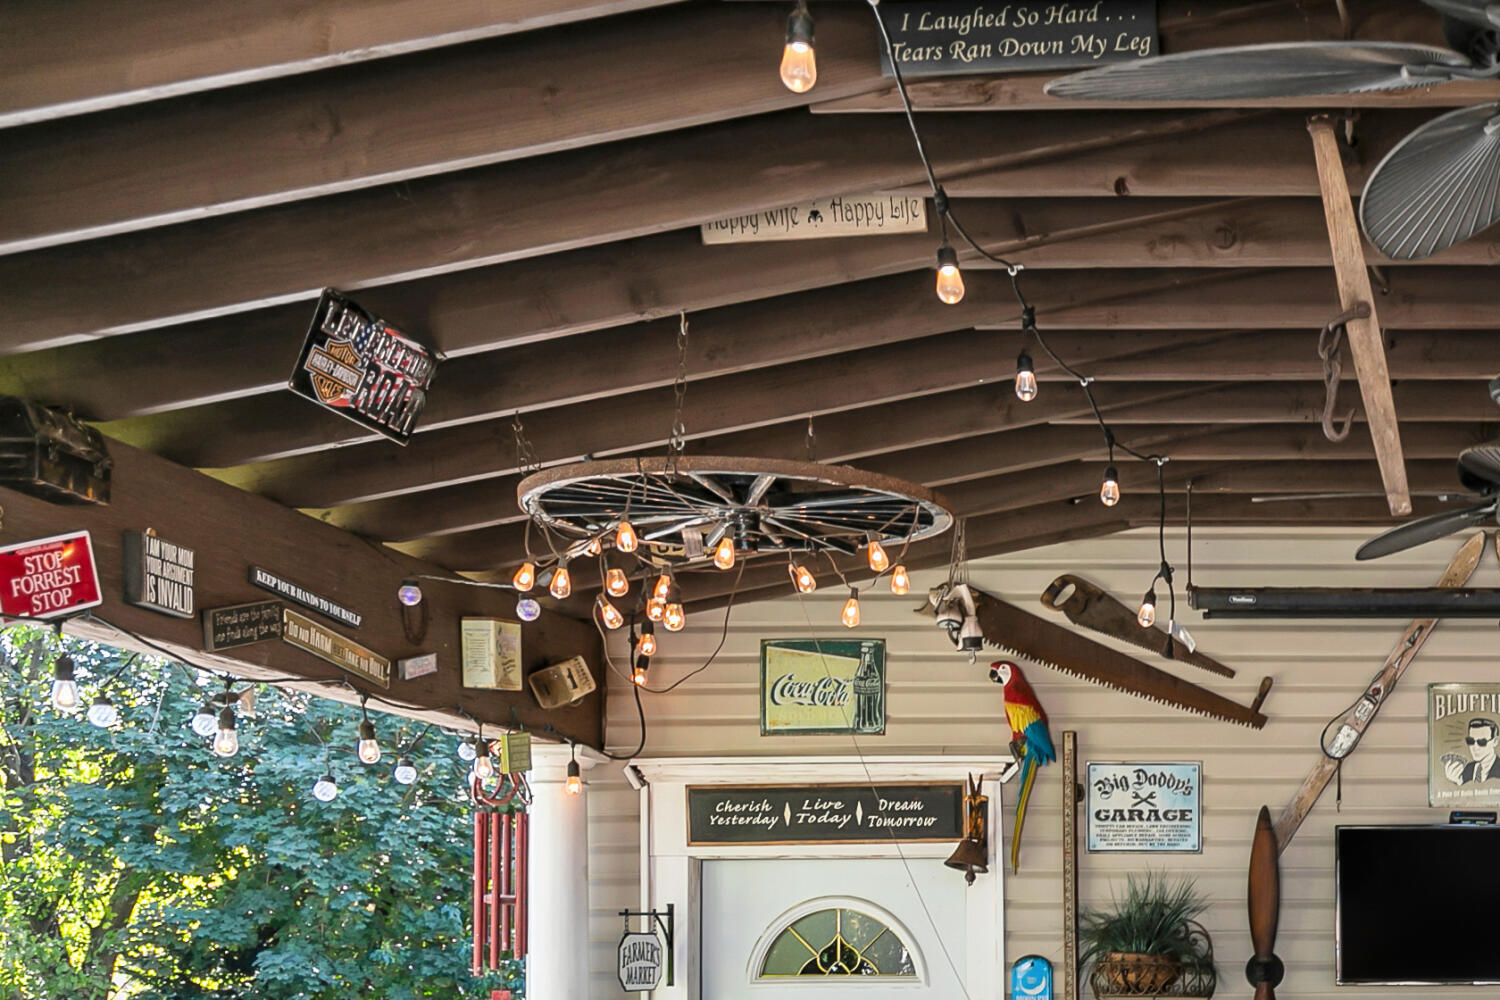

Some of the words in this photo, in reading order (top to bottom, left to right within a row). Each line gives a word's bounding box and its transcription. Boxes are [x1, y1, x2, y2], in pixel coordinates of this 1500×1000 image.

[900, 13, 909, 31] I
[918, 8, 1006, 35] Laughed
[1012, 7, 1039, 28] So
[892, 43, 942, 62] Tears
[950, 40, 992, 62] Ran
[999, 37, 1063, 57] Down
[1071, 34, 1107, 59] My
[1114, 32, 1151, 55] Leg
[830, 198, 883, 226] Happy
[890, 196, 920, 224] Life
[24, 550, 64, 576] STOP
[11, 565, 81, 598] FORREST
[146, 574, 156, 602] IS
[158, 577, 193, 614] INVALID
[32, 588, 73, 613] STOP
[256, 570, 277, 589] KEEP
[277, 580, 296, 597] YOUR
[296, 587, 319, 607] HANDS
[319, 598, 329, 612] TO
[329, 602, 362, 627] YOURSELF
[1094, 773, 1129, 800] Big
[1132, 768, 1193, 796] Daddy's
[715, 799, 773, 813] Cherish
[802, 798, 846, 810] Live
[878, 799, 924, 811] Dream
[1094, 809, 1192, 822] GARAGE
[709, 814, 779, 830] Yesterday
[796, 812, 852, 829] Today
[868, 815, 937, 828] Tomorrow
[622, 941, 660, 968] FARMERS
[626, 966, 657, 984] MARKET
